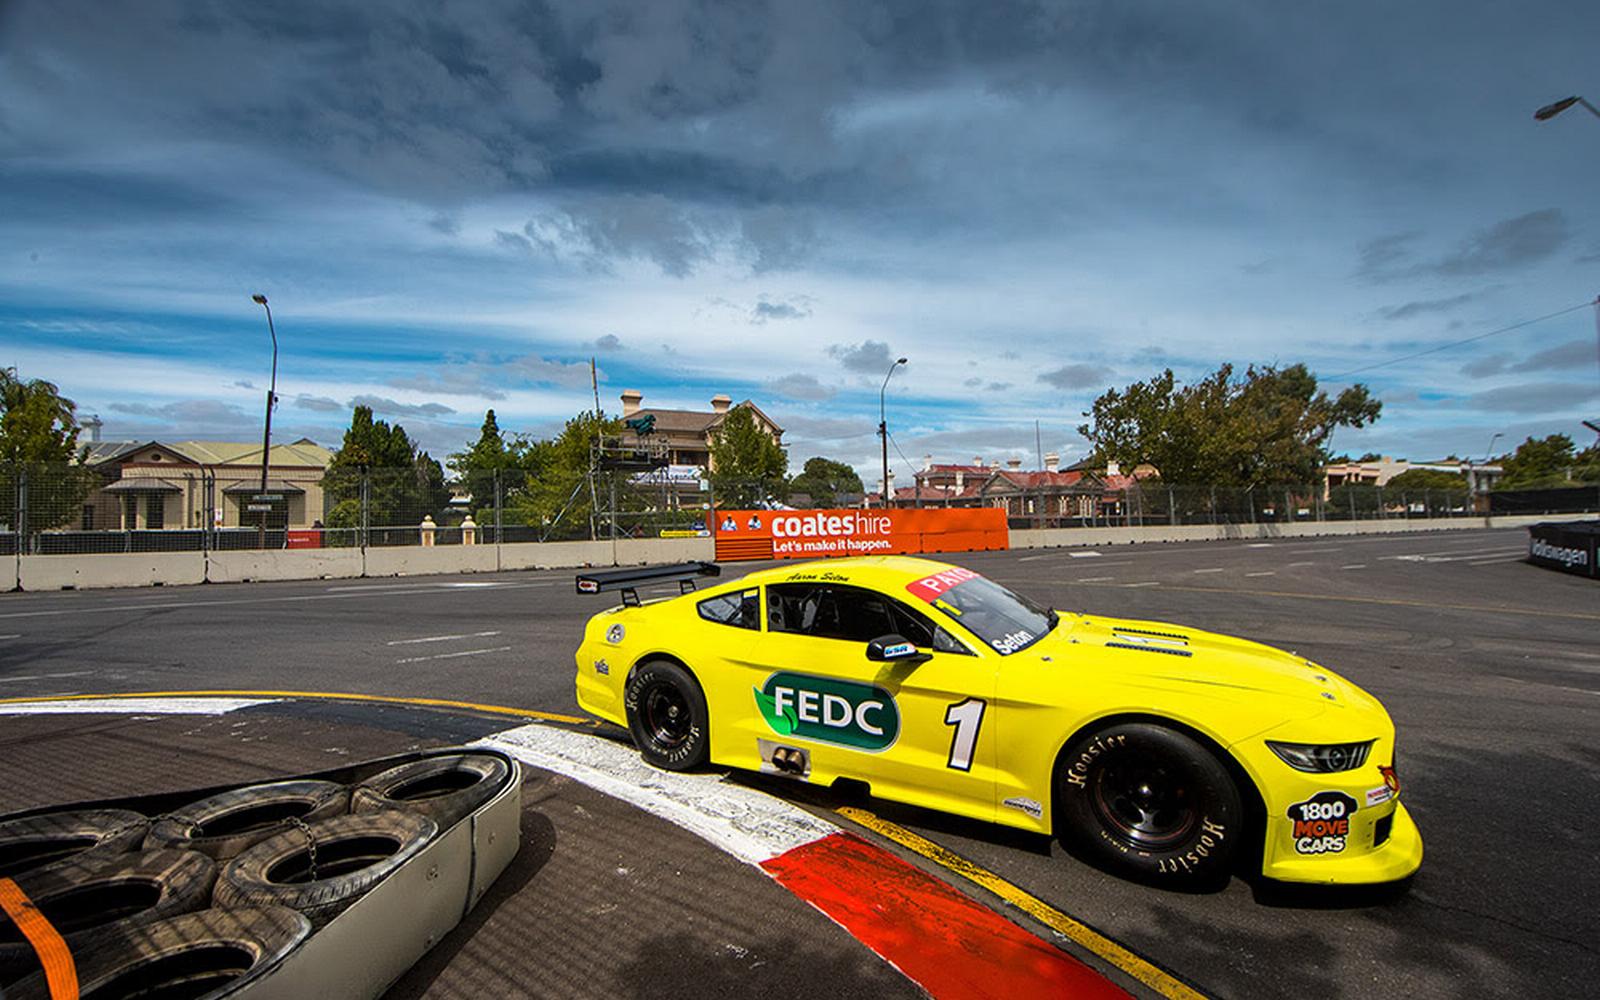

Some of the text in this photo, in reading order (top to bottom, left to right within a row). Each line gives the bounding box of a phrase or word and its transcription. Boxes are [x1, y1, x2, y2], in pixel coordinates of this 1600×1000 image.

[773, 538, 892, 552] Let's make it happen.
[991, 630, 1034, 655] Seton
[774, 686, 884, 736] FEDC
[944, 697, 986, 773] 1
[1067, 735, 1126, 789] Hoosier
[1299, 801, 1345, 820] 1800
[1295, 820, 1348, 838] MOVE
[1158, 817, 1226, 874] Hoosier
[1297, 837, 1344, 852] CARS
